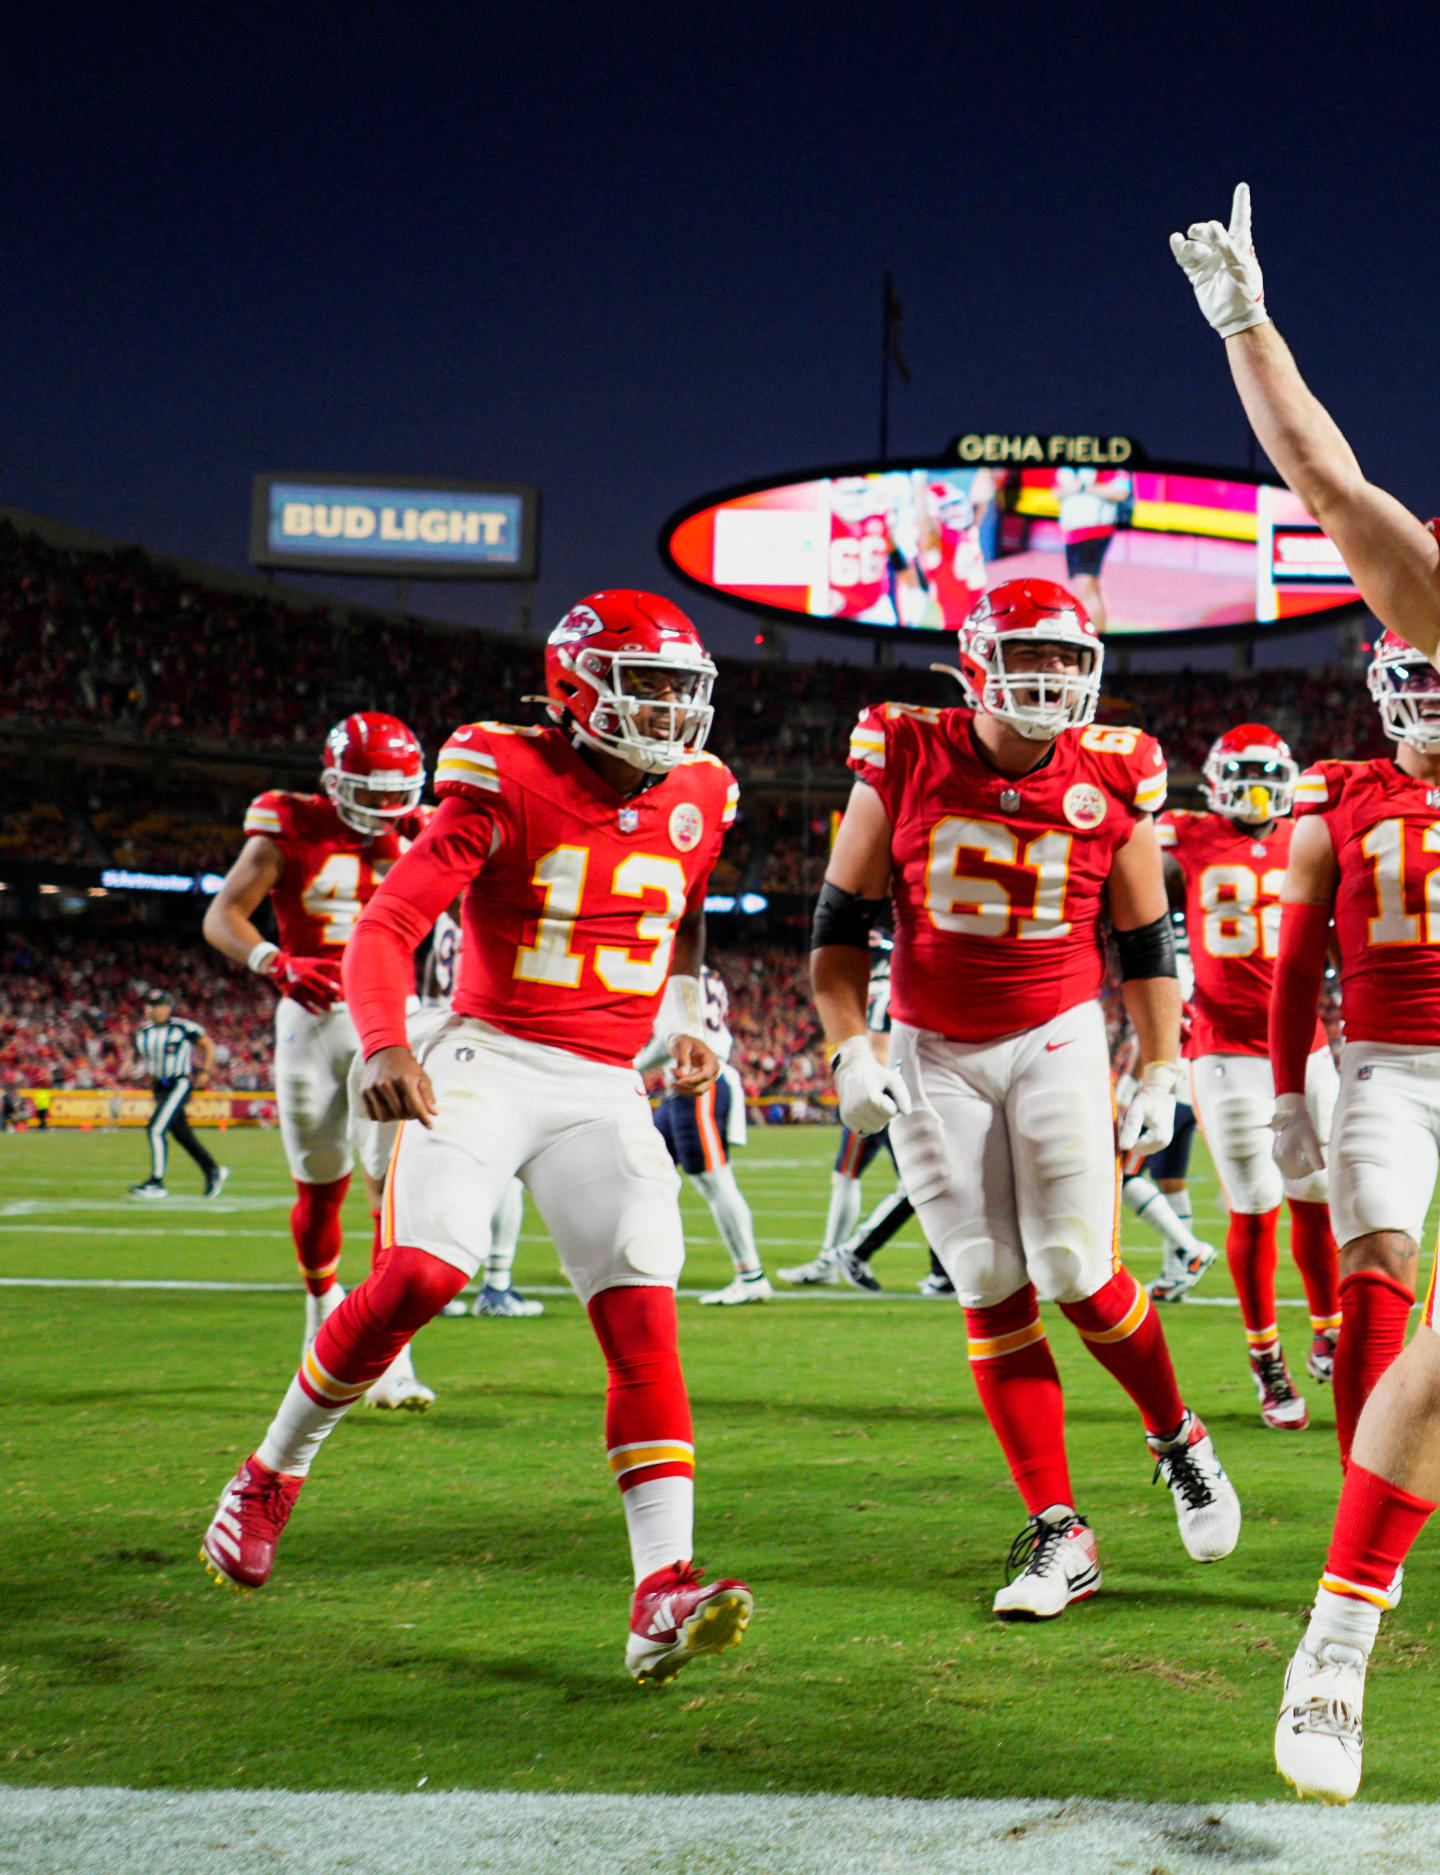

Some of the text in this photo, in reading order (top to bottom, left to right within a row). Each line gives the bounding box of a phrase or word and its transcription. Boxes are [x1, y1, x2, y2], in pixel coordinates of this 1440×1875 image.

[958, 434, 1132, 463] GEHA FIELD
[282, 503, 508, 545] BUD LIGHT
[830, 537, 887, 586] 66
[924, 815, 1073, 940] 61
[513, 843, 687, 996] 13
